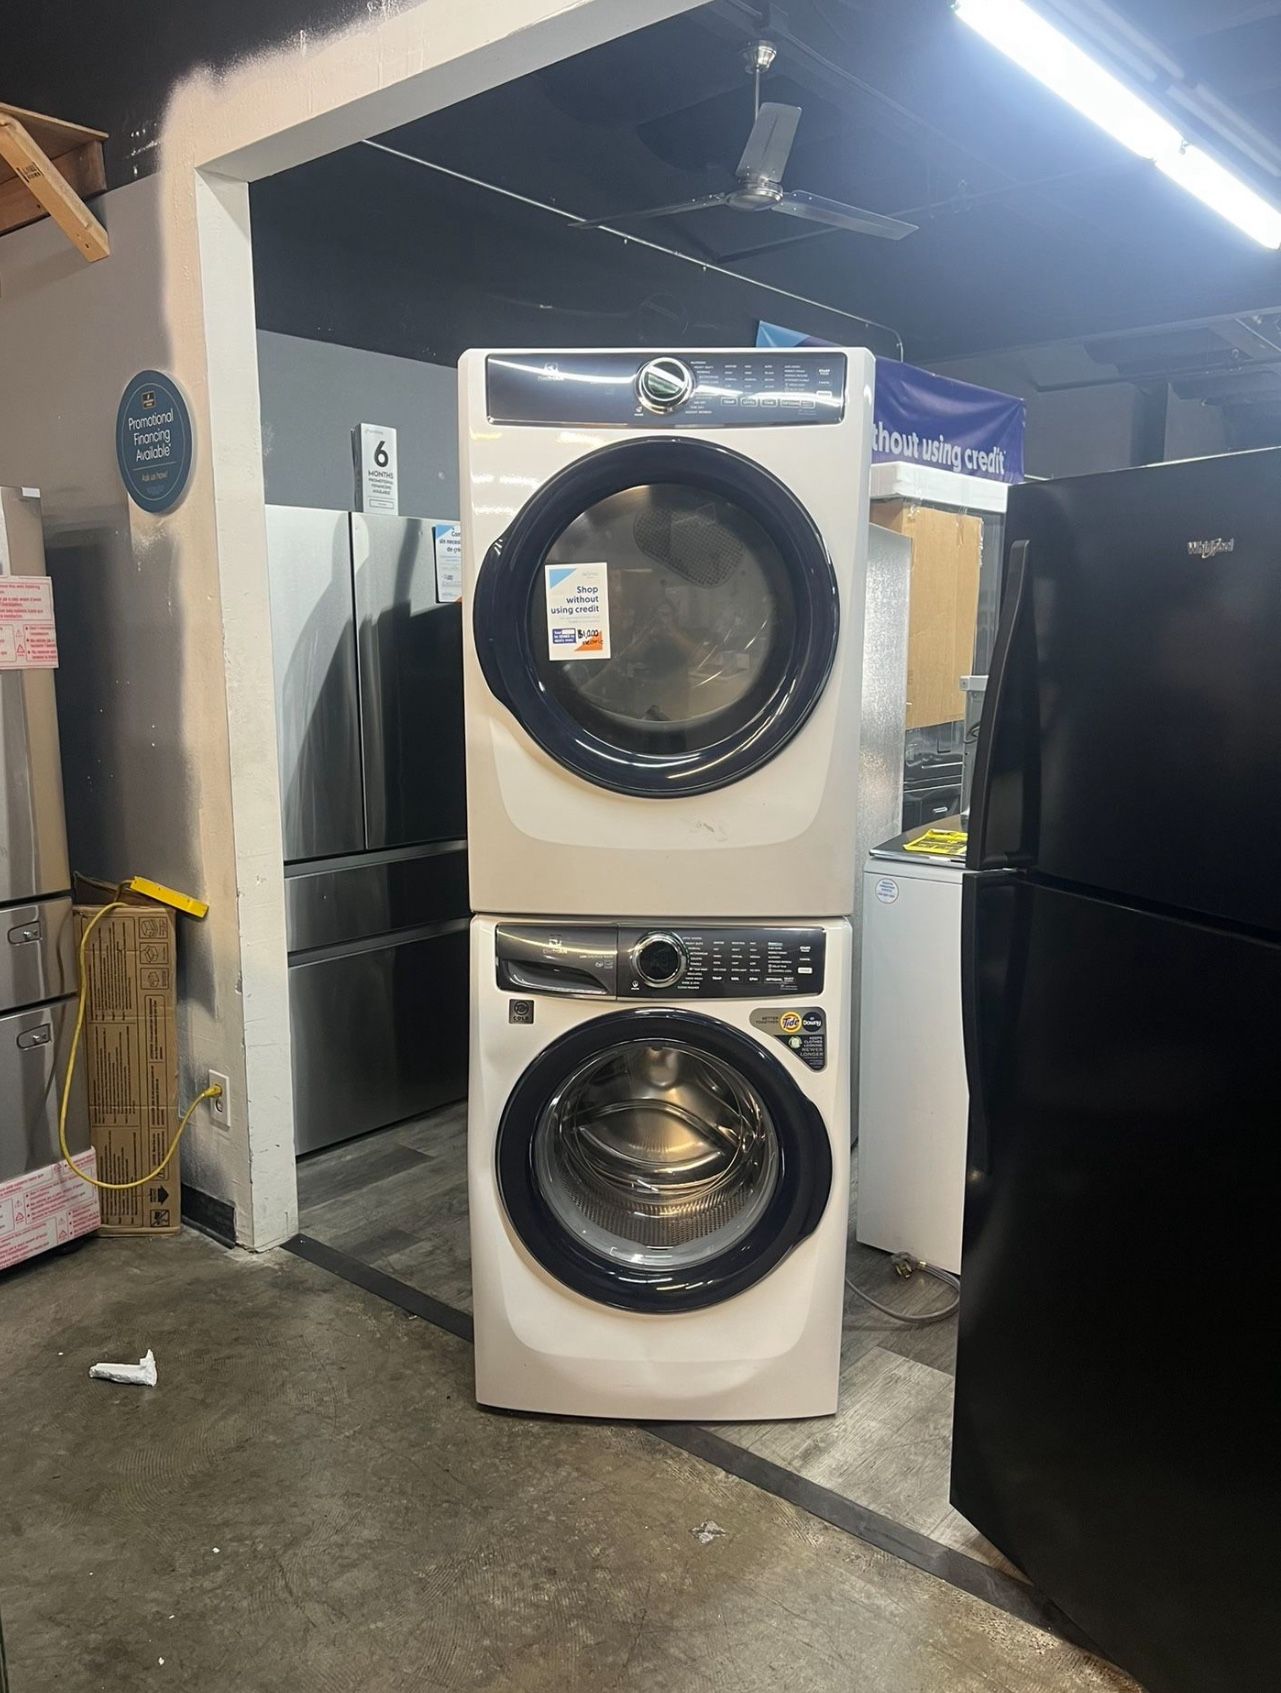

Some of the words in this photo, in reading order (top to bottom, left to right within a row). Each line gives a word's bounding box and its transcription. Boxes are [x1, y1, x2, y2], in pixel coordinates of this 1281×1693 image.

[128, 408, 174, 431] Promotional
[133, 428, 171, 446] Financing
[872, 421, 919, 459] thout
[922, 434, 961, 473] using
[374, 440, 389, 468] 6
[368, 470, 393, 480] MONTHS
[576, 586, 599, 594] Shop
[566, 596, 599, 604] without
[551, 606, 574, 615] using
[575, 605, 599, 613] credit
[783, 1017, 800, 1029] Tide
